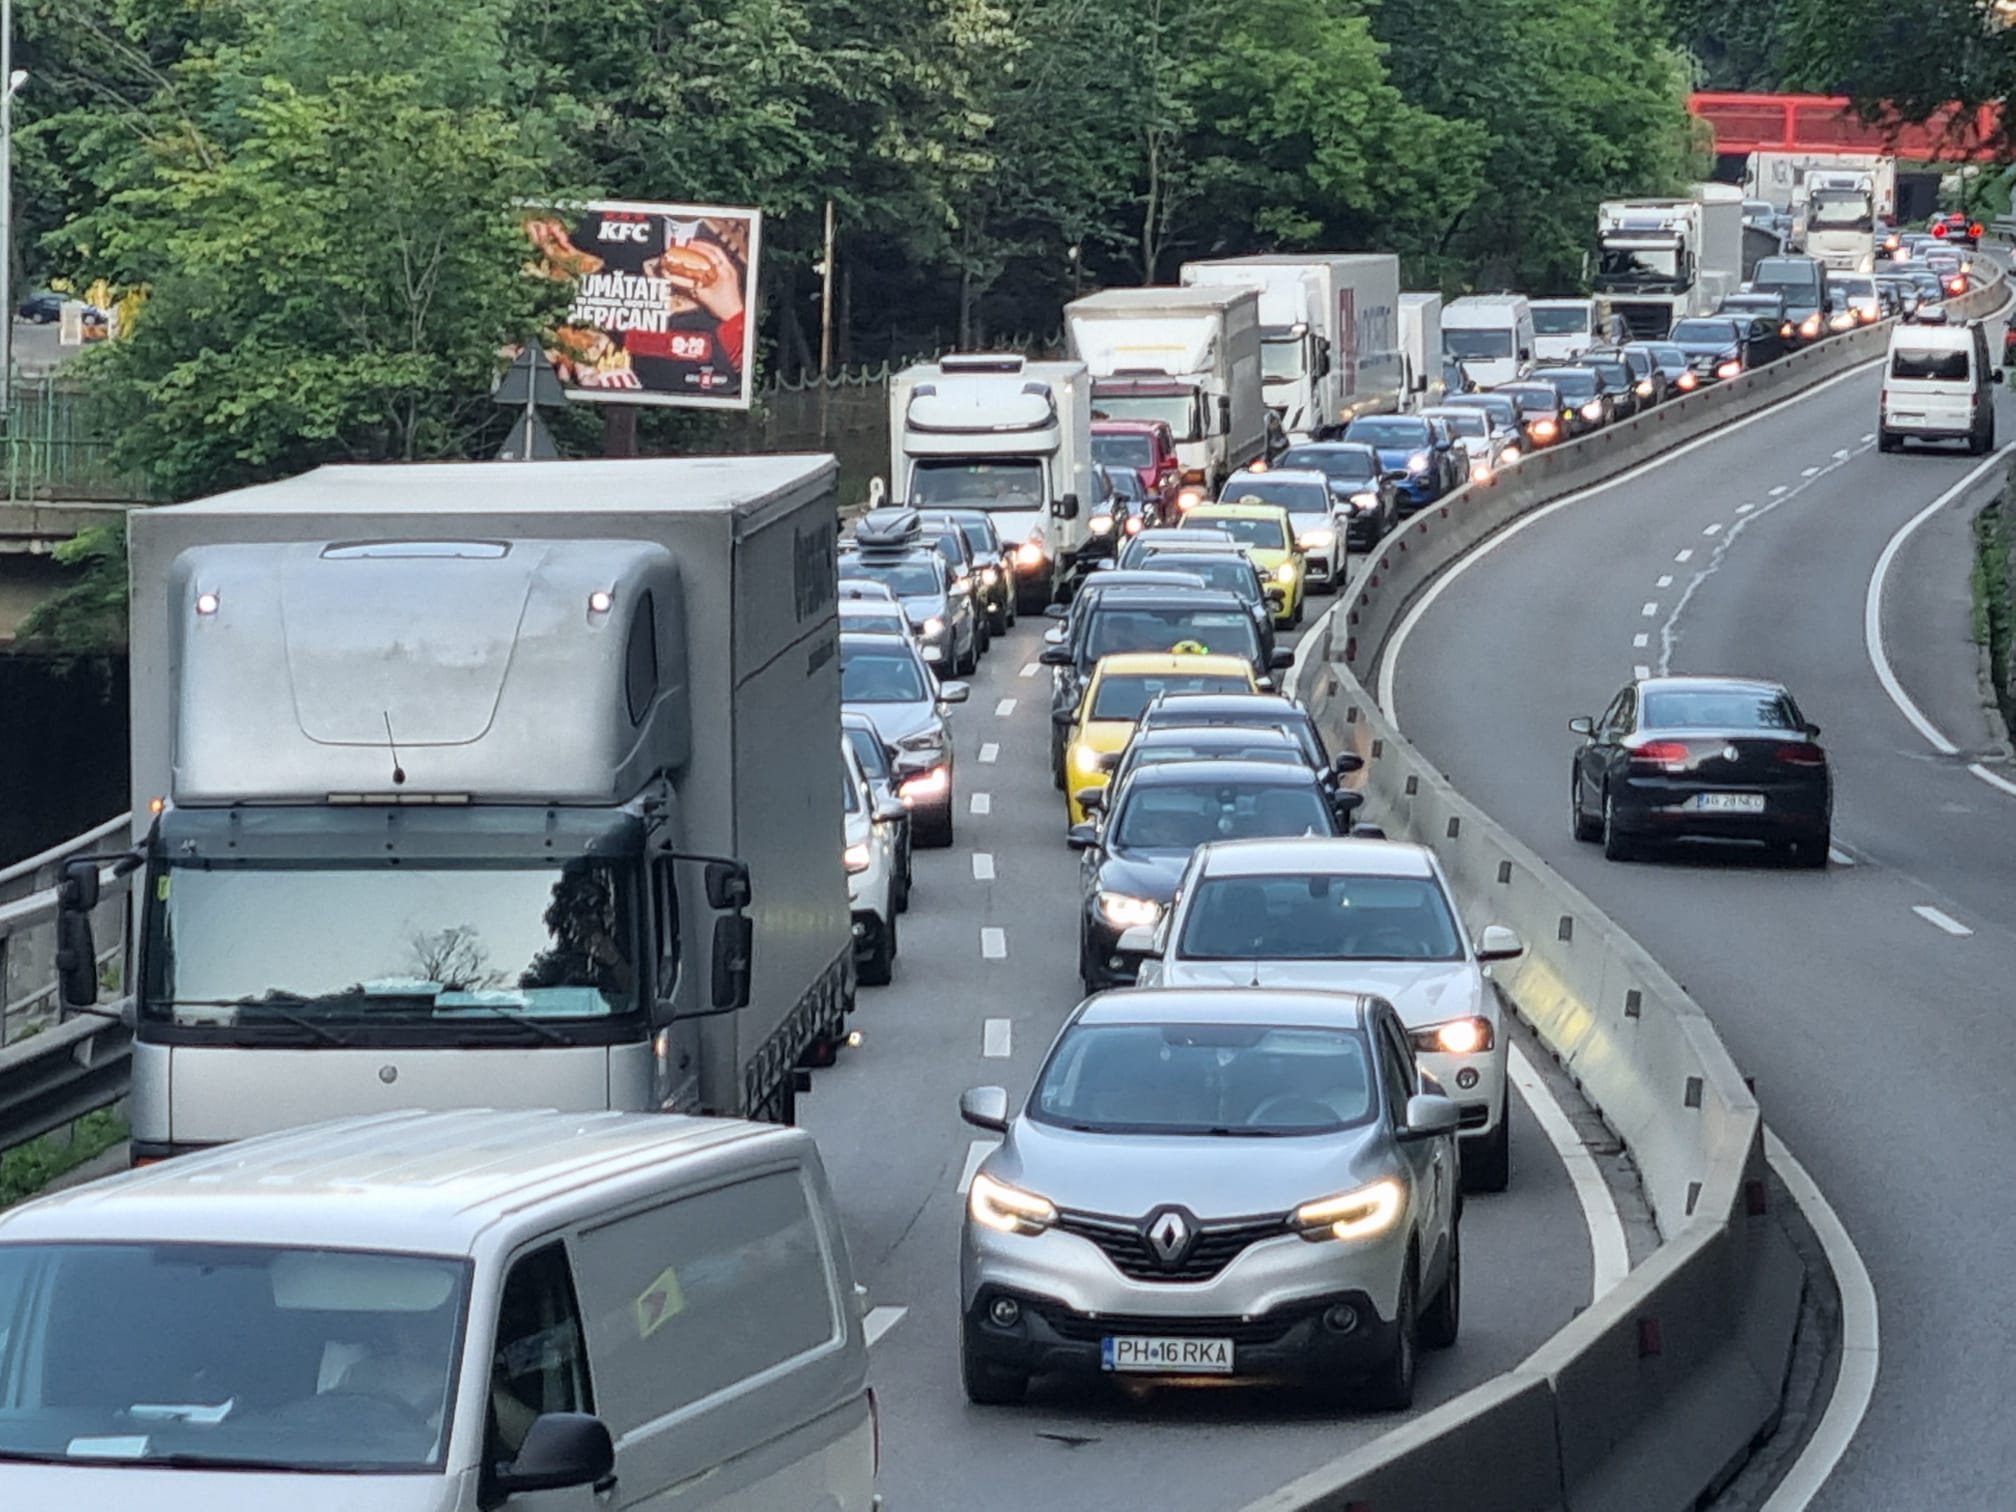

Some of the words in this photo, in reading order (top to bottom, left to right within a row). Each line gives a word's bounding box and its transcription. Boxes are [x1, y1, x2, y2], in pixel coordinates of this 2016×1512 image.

[597, 221, 650, 242] KFC
[579, 269, 671, 300] UMĂTATE
[1117, 1340, 1150, 1362] PH
[1158, 1341, 1178, 1363] 16
[1183, 1342, 1227, 1363] RKA
